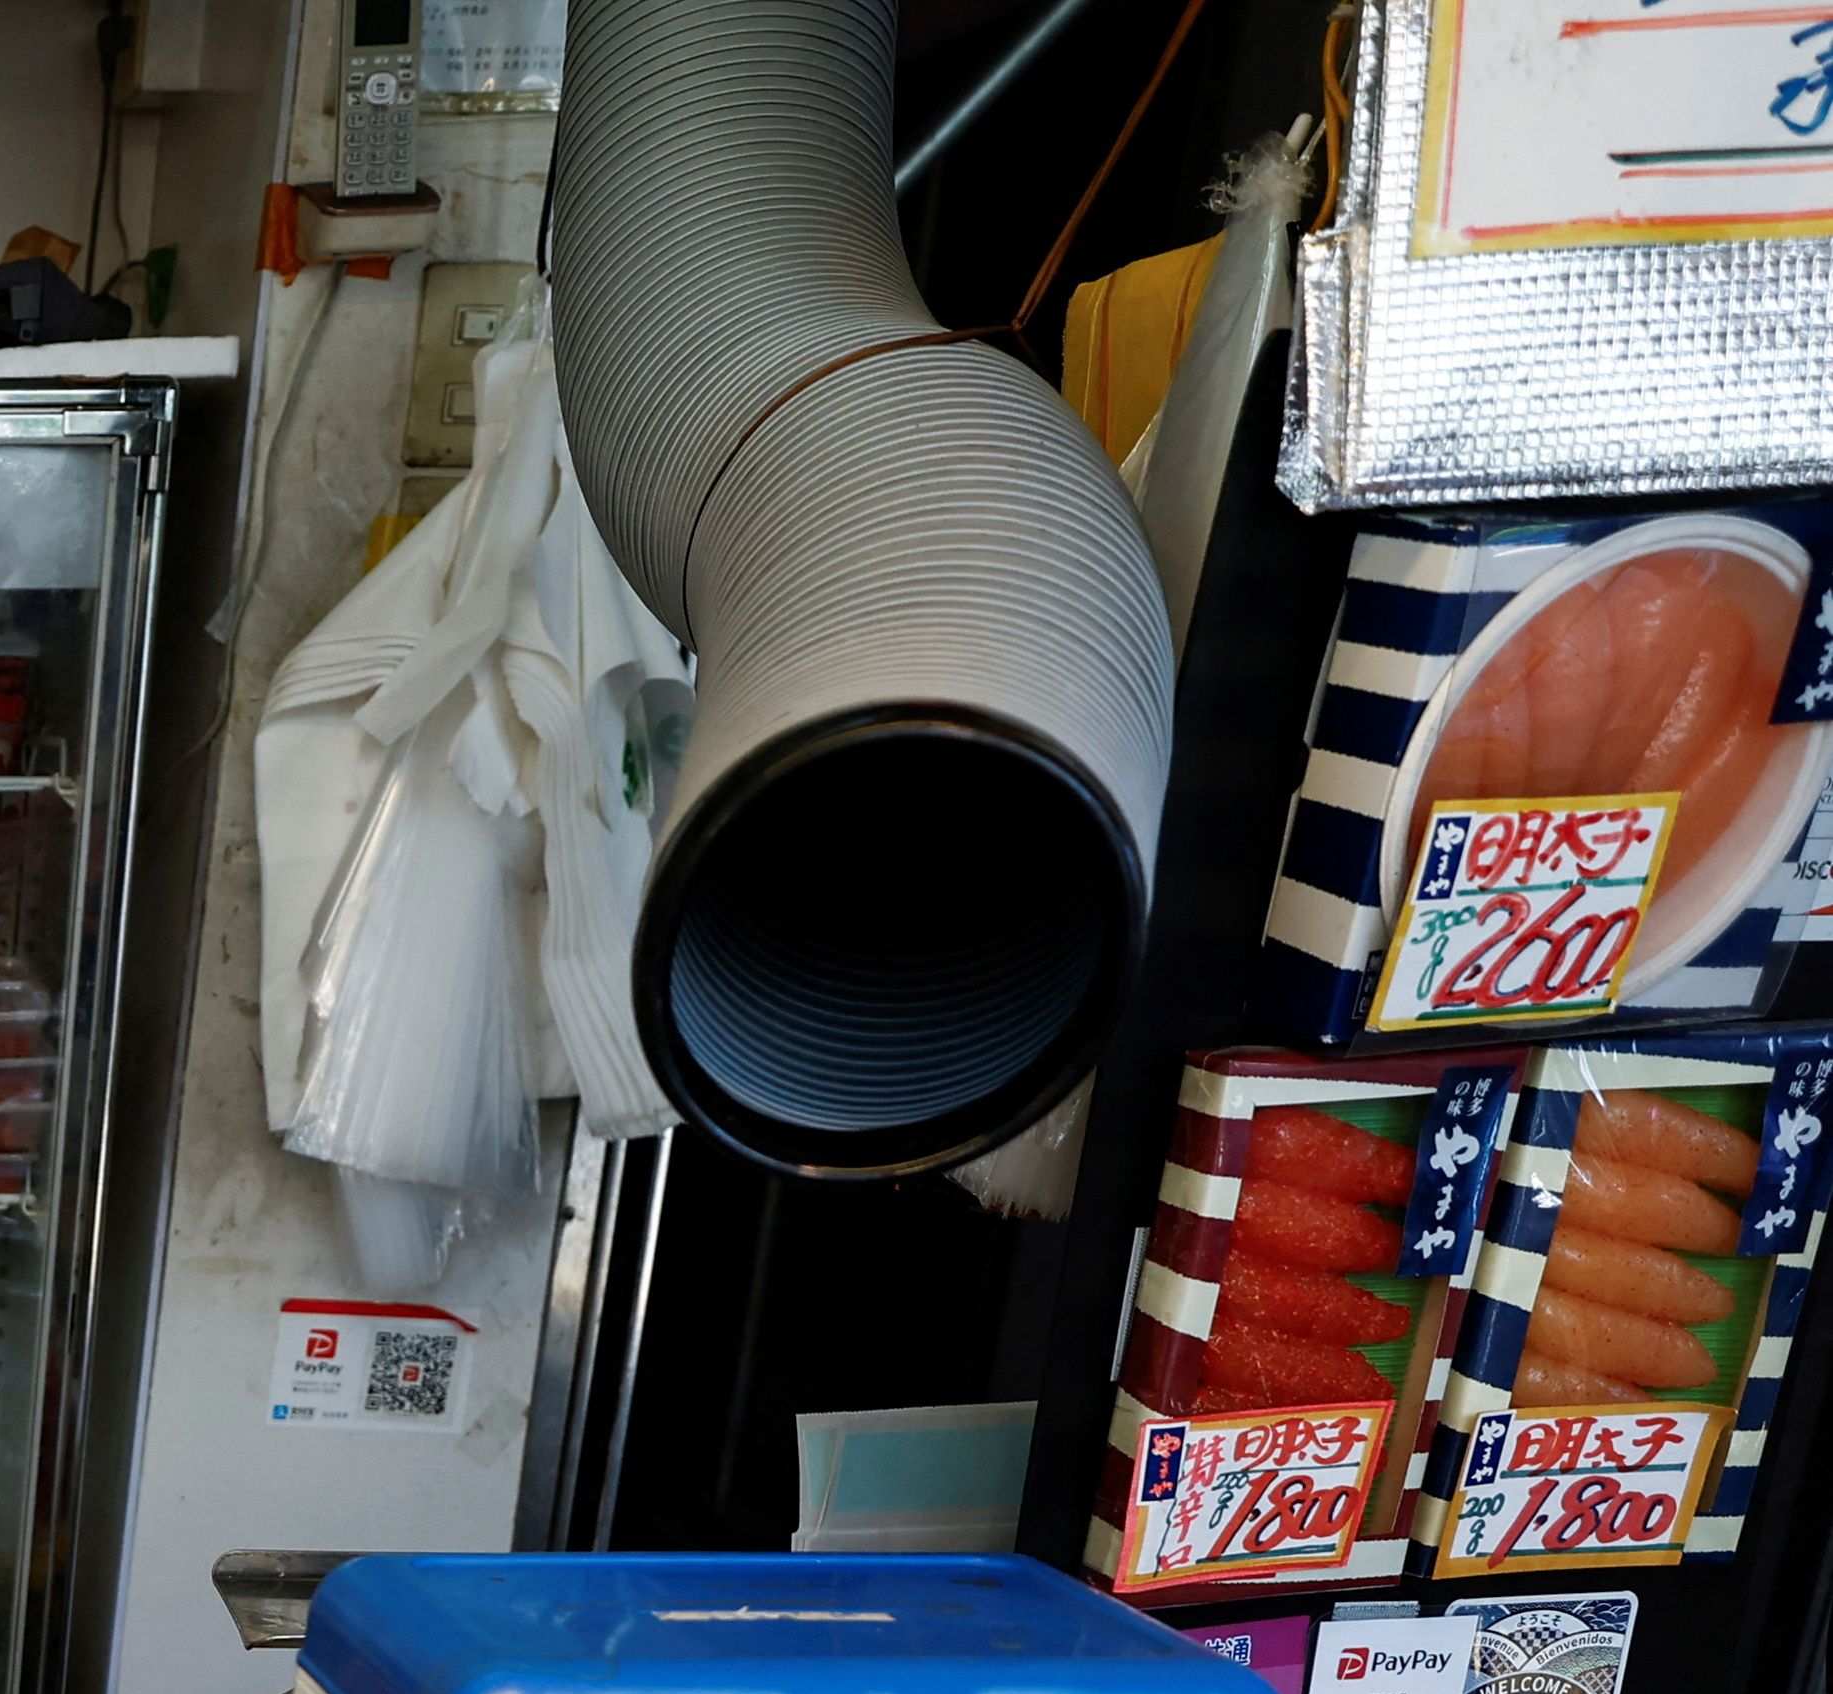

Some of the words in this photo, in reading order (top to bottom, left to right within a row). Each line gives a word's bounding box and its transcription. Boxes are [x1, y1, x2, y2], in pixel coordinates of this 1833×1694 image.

[1422, 820, 1465, 899] やまや
[1466, 809, 1650, 891] 明太子
[1445, 1080, 1471, 1116] の味
[1466, 1079, 1495, 1115] 博多
[1788, 1062, 1812, 1099] の味
[1414, 1127, 1480, 1261] やまや
[1754, 1107, 1822, 1240] やまや
[295, 1360, 342, 1376] PayPay
[1233, 1417, 1368, 1471] 明太子
[1470, 1418, 1506, 1485] やまや
[1512, 1417, 1685, 1476] 明太子
[1158, 1435, 1223, 1571] 特辛口
[1516, 1614, 1562, 1629] ようこそ
[1371, 1650, 1453, 1675] PayPay
[1536, 1634, 1613, 1665] Bienvenidos
